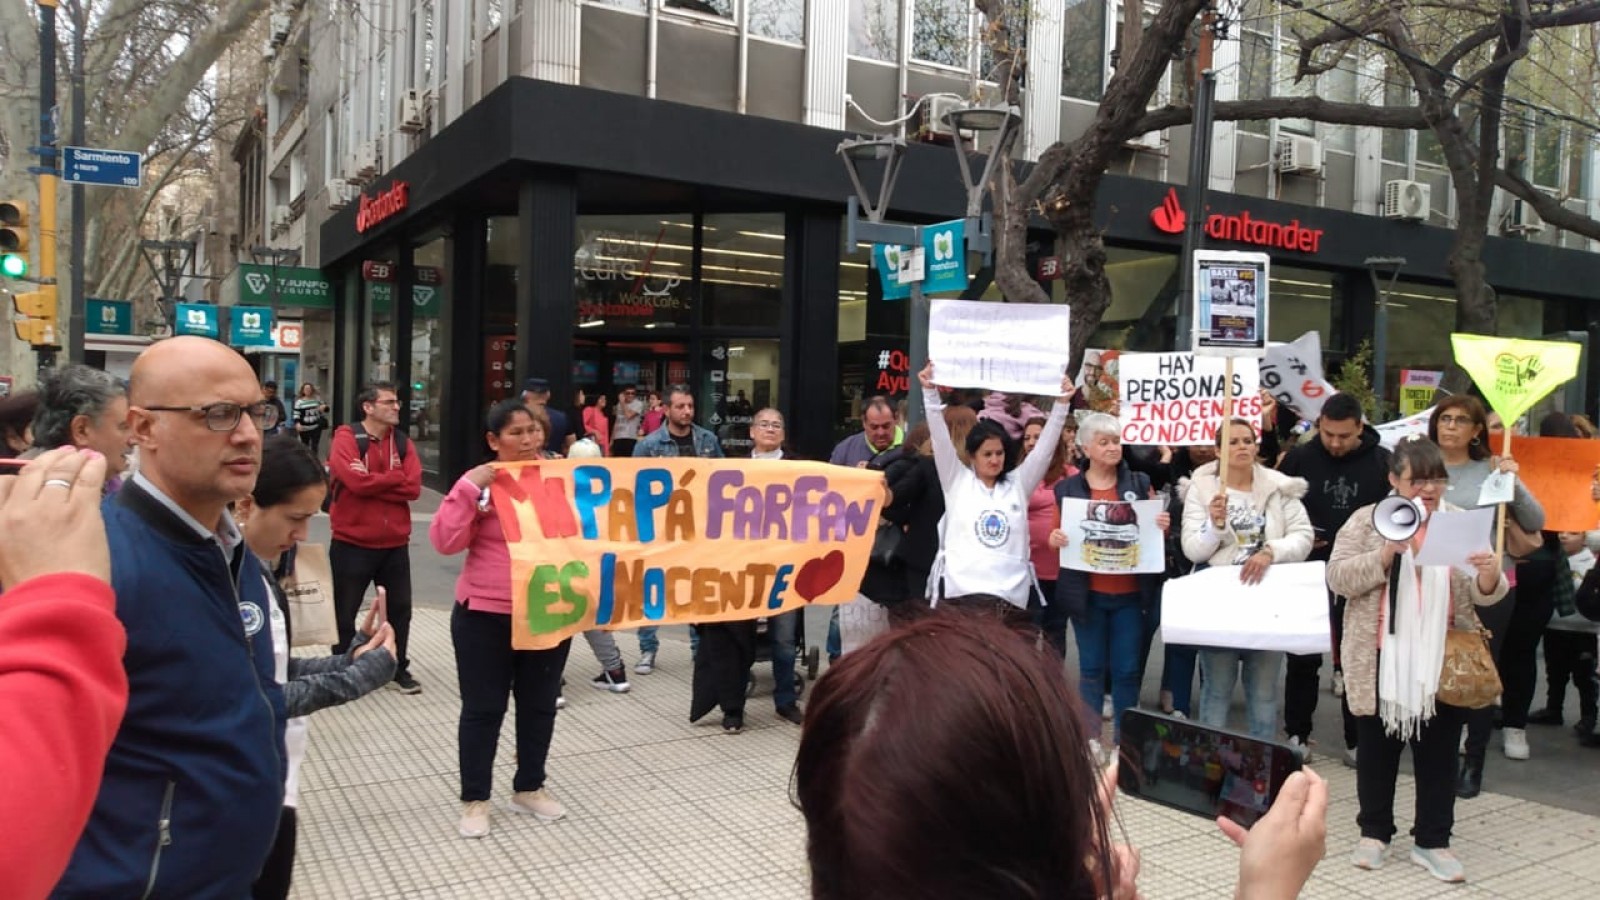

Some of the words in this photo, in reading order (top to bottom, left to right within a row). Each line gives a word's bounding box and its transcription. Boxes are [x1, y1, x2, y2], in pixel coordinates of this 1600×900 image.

[73, 149, 131, 165] Sarmiento
[123, 177, 137, 185] 100
[1204, 200, 1323, 253] antander
[1159, 355, 1194, 375] HAY
[1127, 374, 1243, 401] PERSONAS
[1131, 396, 1262, 421] INOCENTES
[573, 464, 697, 544] PAPÁ
[706, 470, 876, 543] FARFAN
[527, 560, 590, 636] ES
[595, 552, 795, 625] INOCENTE
